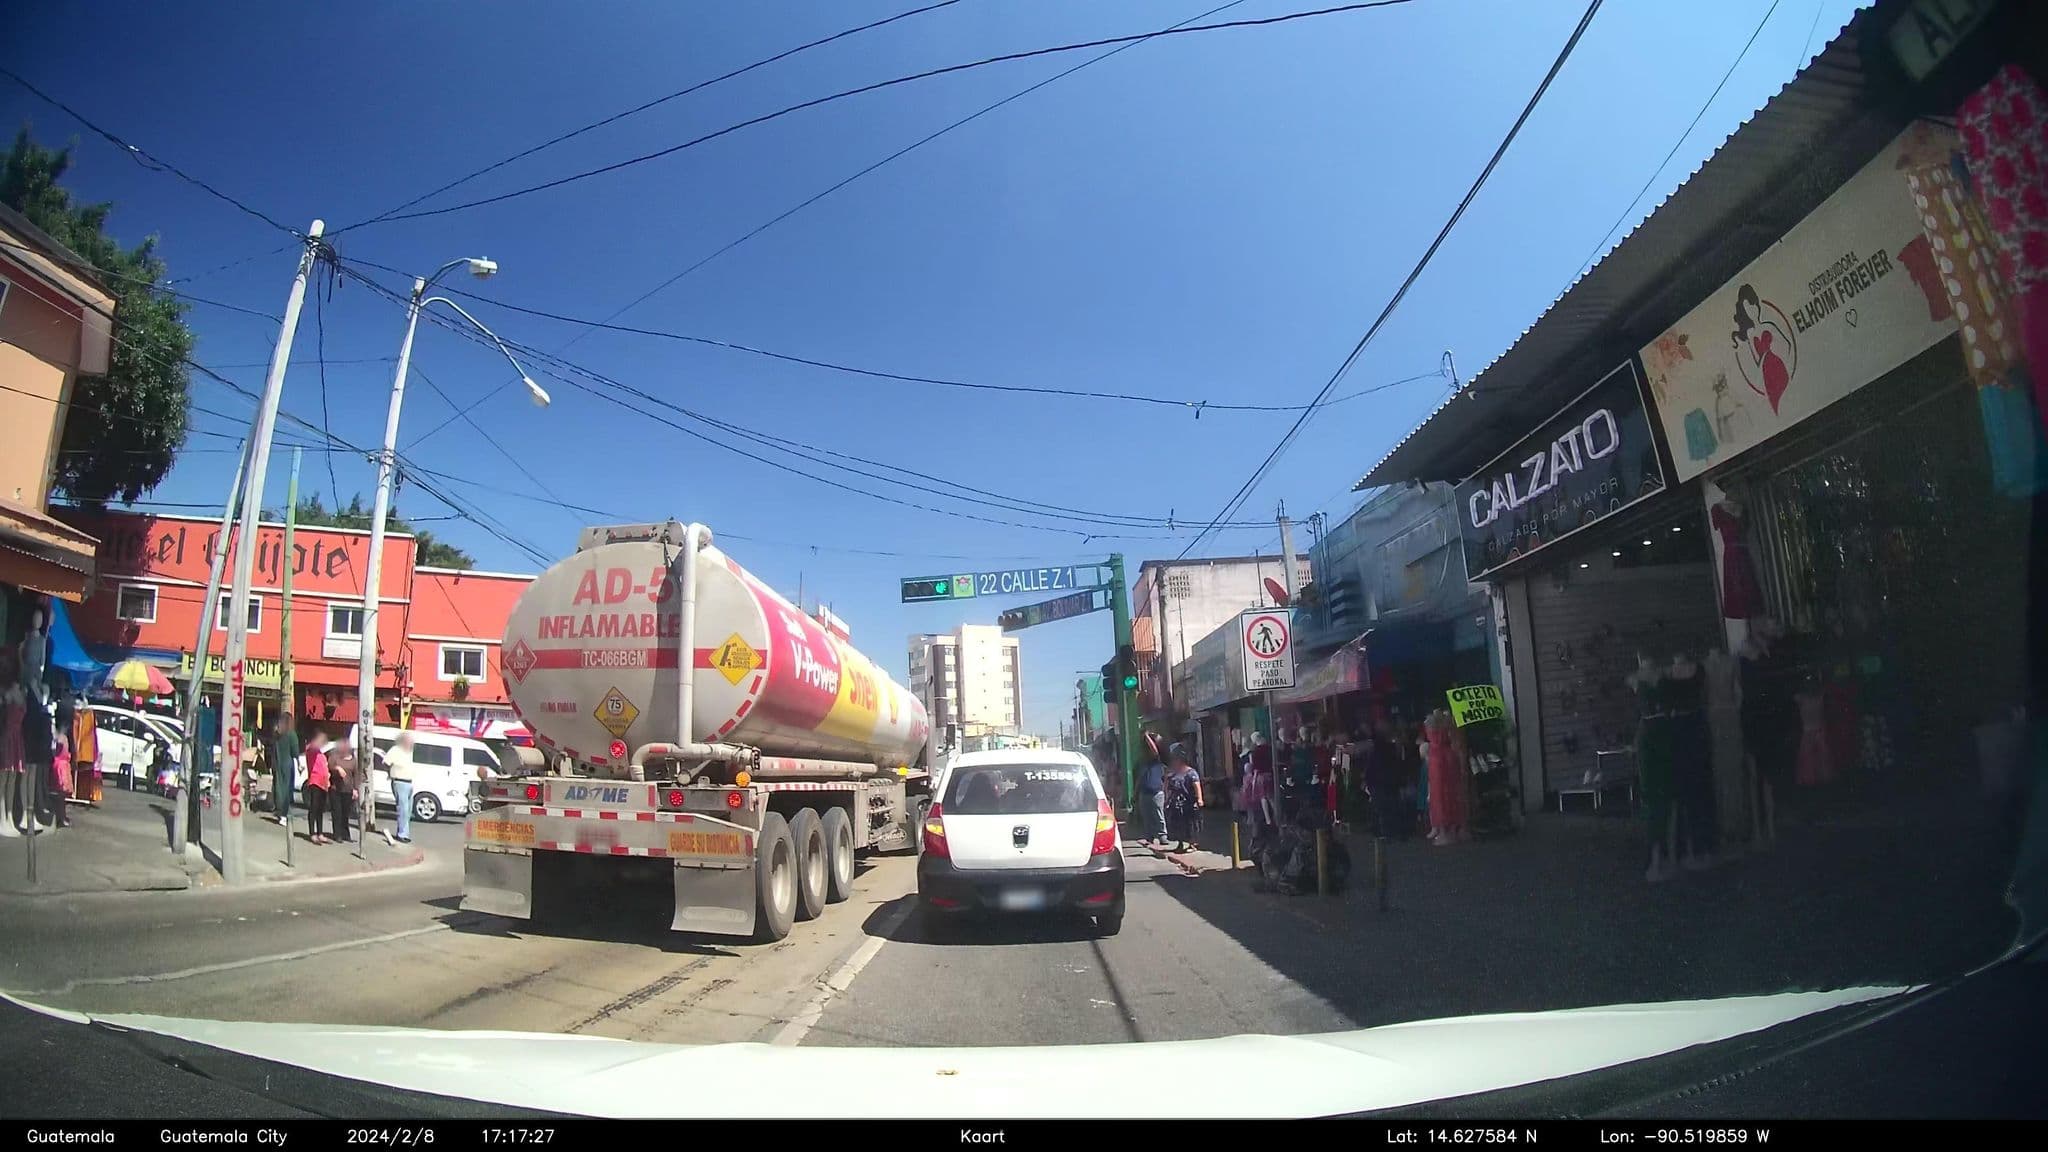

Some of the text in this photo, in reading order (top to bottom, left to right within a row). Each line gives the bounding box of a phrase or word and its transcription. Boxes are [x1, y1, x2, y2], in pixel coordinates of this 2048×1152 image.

[1808, 251, 1859, 296] DISTRIBUIDORA
[1792, 248, 1893, 334] ELHOIM FOREVER
[1469, 409, 1620, 528] CALZATO
[1488, 477, 1618, 551] CALZADO POR MAYOR
[572, 566, 674, 606] AD-5
[980, 567, 1073, 594] 22 CALLE Z.1
[538, 613, 681, 640] INFLAMABLE
[583, 650, 647, 667] TC-066BGM
[790, 640, 838, 695] V-Power
[1254, 660, 1284, 669] RESPETE
[1252, 678, 1288, 687] PEATONAL
[1260, 669, 1279, 677] PASO
[610, 698, 622, 709] 75
[478, 820, 534, 836] EMERGENCIAS
